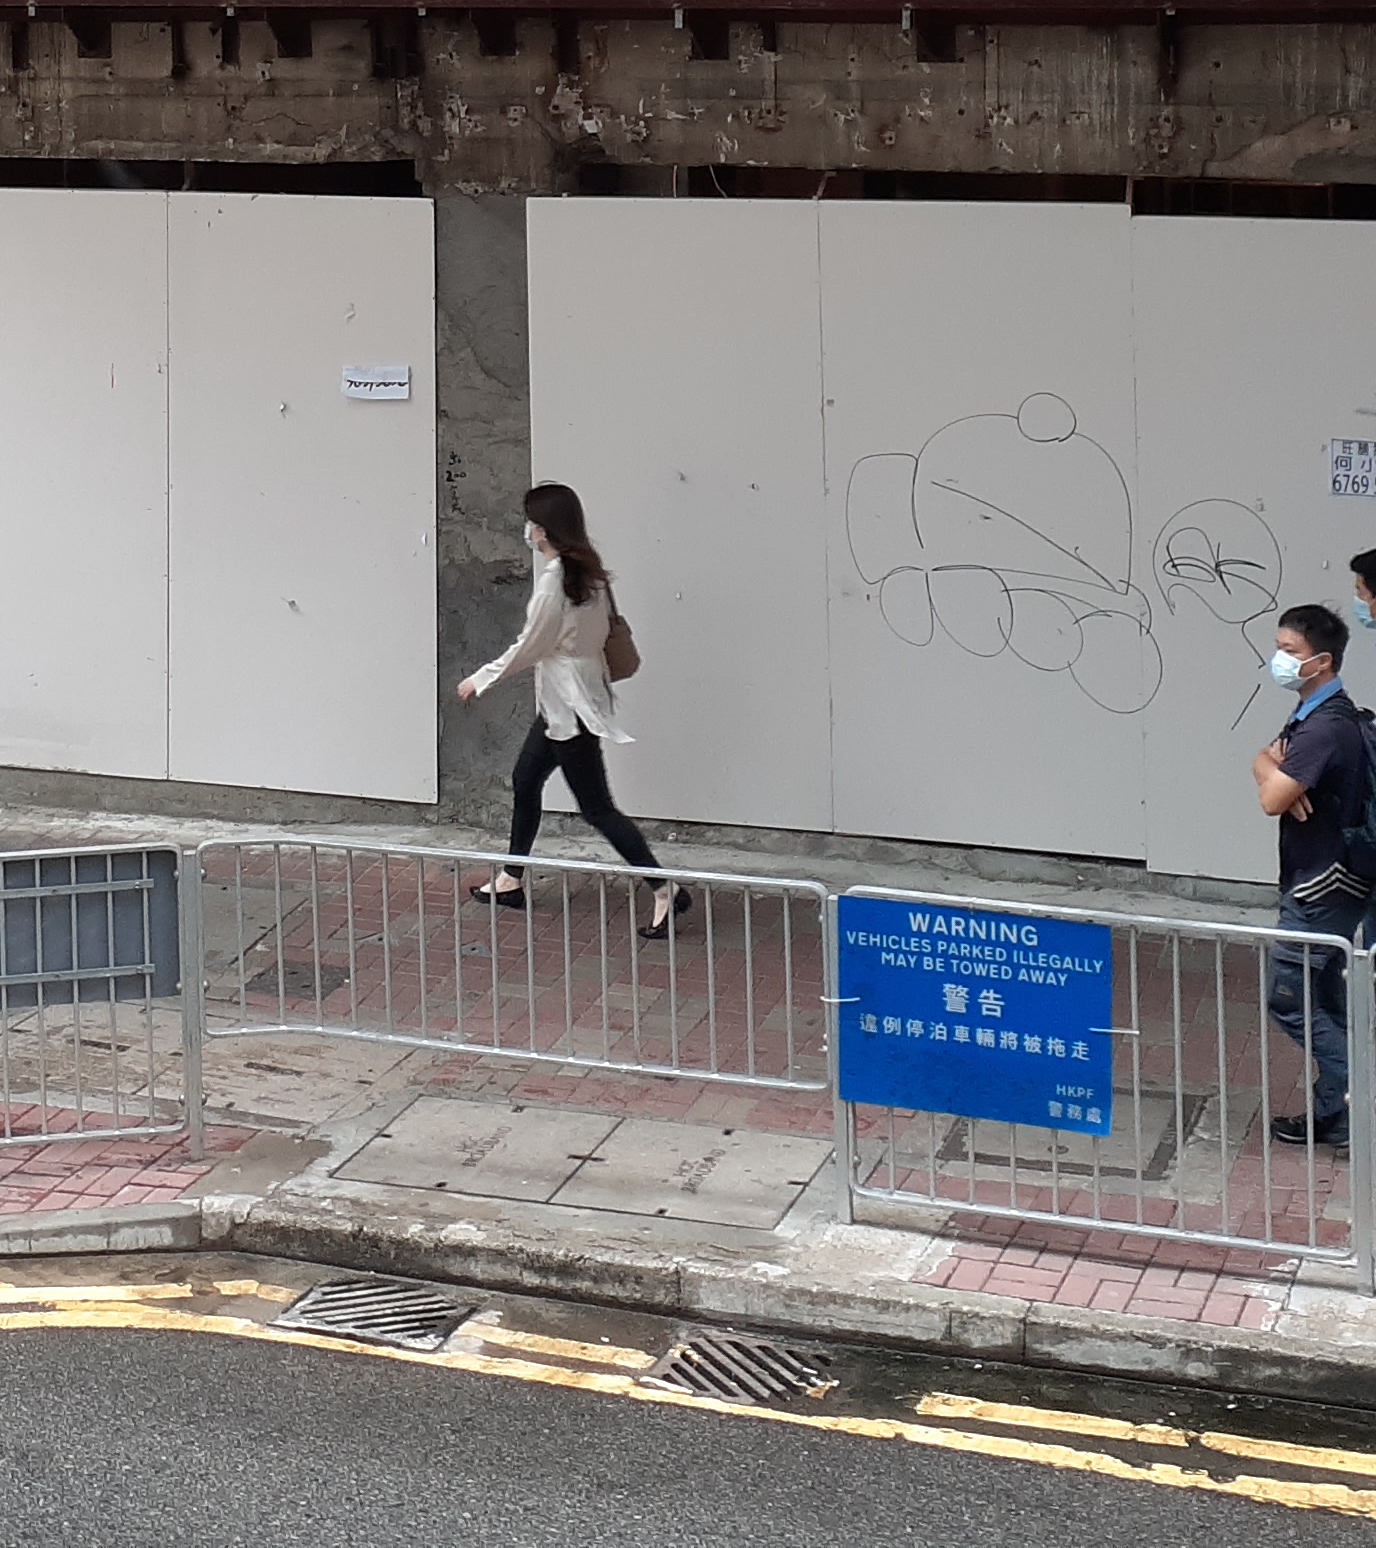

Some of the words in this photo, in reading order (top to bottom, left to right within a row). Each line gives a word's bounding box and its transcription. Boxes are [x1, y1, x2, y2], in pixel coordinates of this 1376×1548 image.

[1332, 474, 1369, 493] 6769
[909, 912, 1038, 946] WARNING
[847, 931, 931, 953] VEHICLES
[937, 941, 1007, 961] PARKED
[1013, 950, 1103, 973] ILLEGALLY
[881, 953, 919, 968] MAY
[924, 957, 945, 971] BE
[951, 960, 1012, 980] TOWED
[1018, 968, 1068, 986] AWAY
[943, 983, 1005, 1018] 警告
[1056, 1084, 1094, 1099] HKPF
